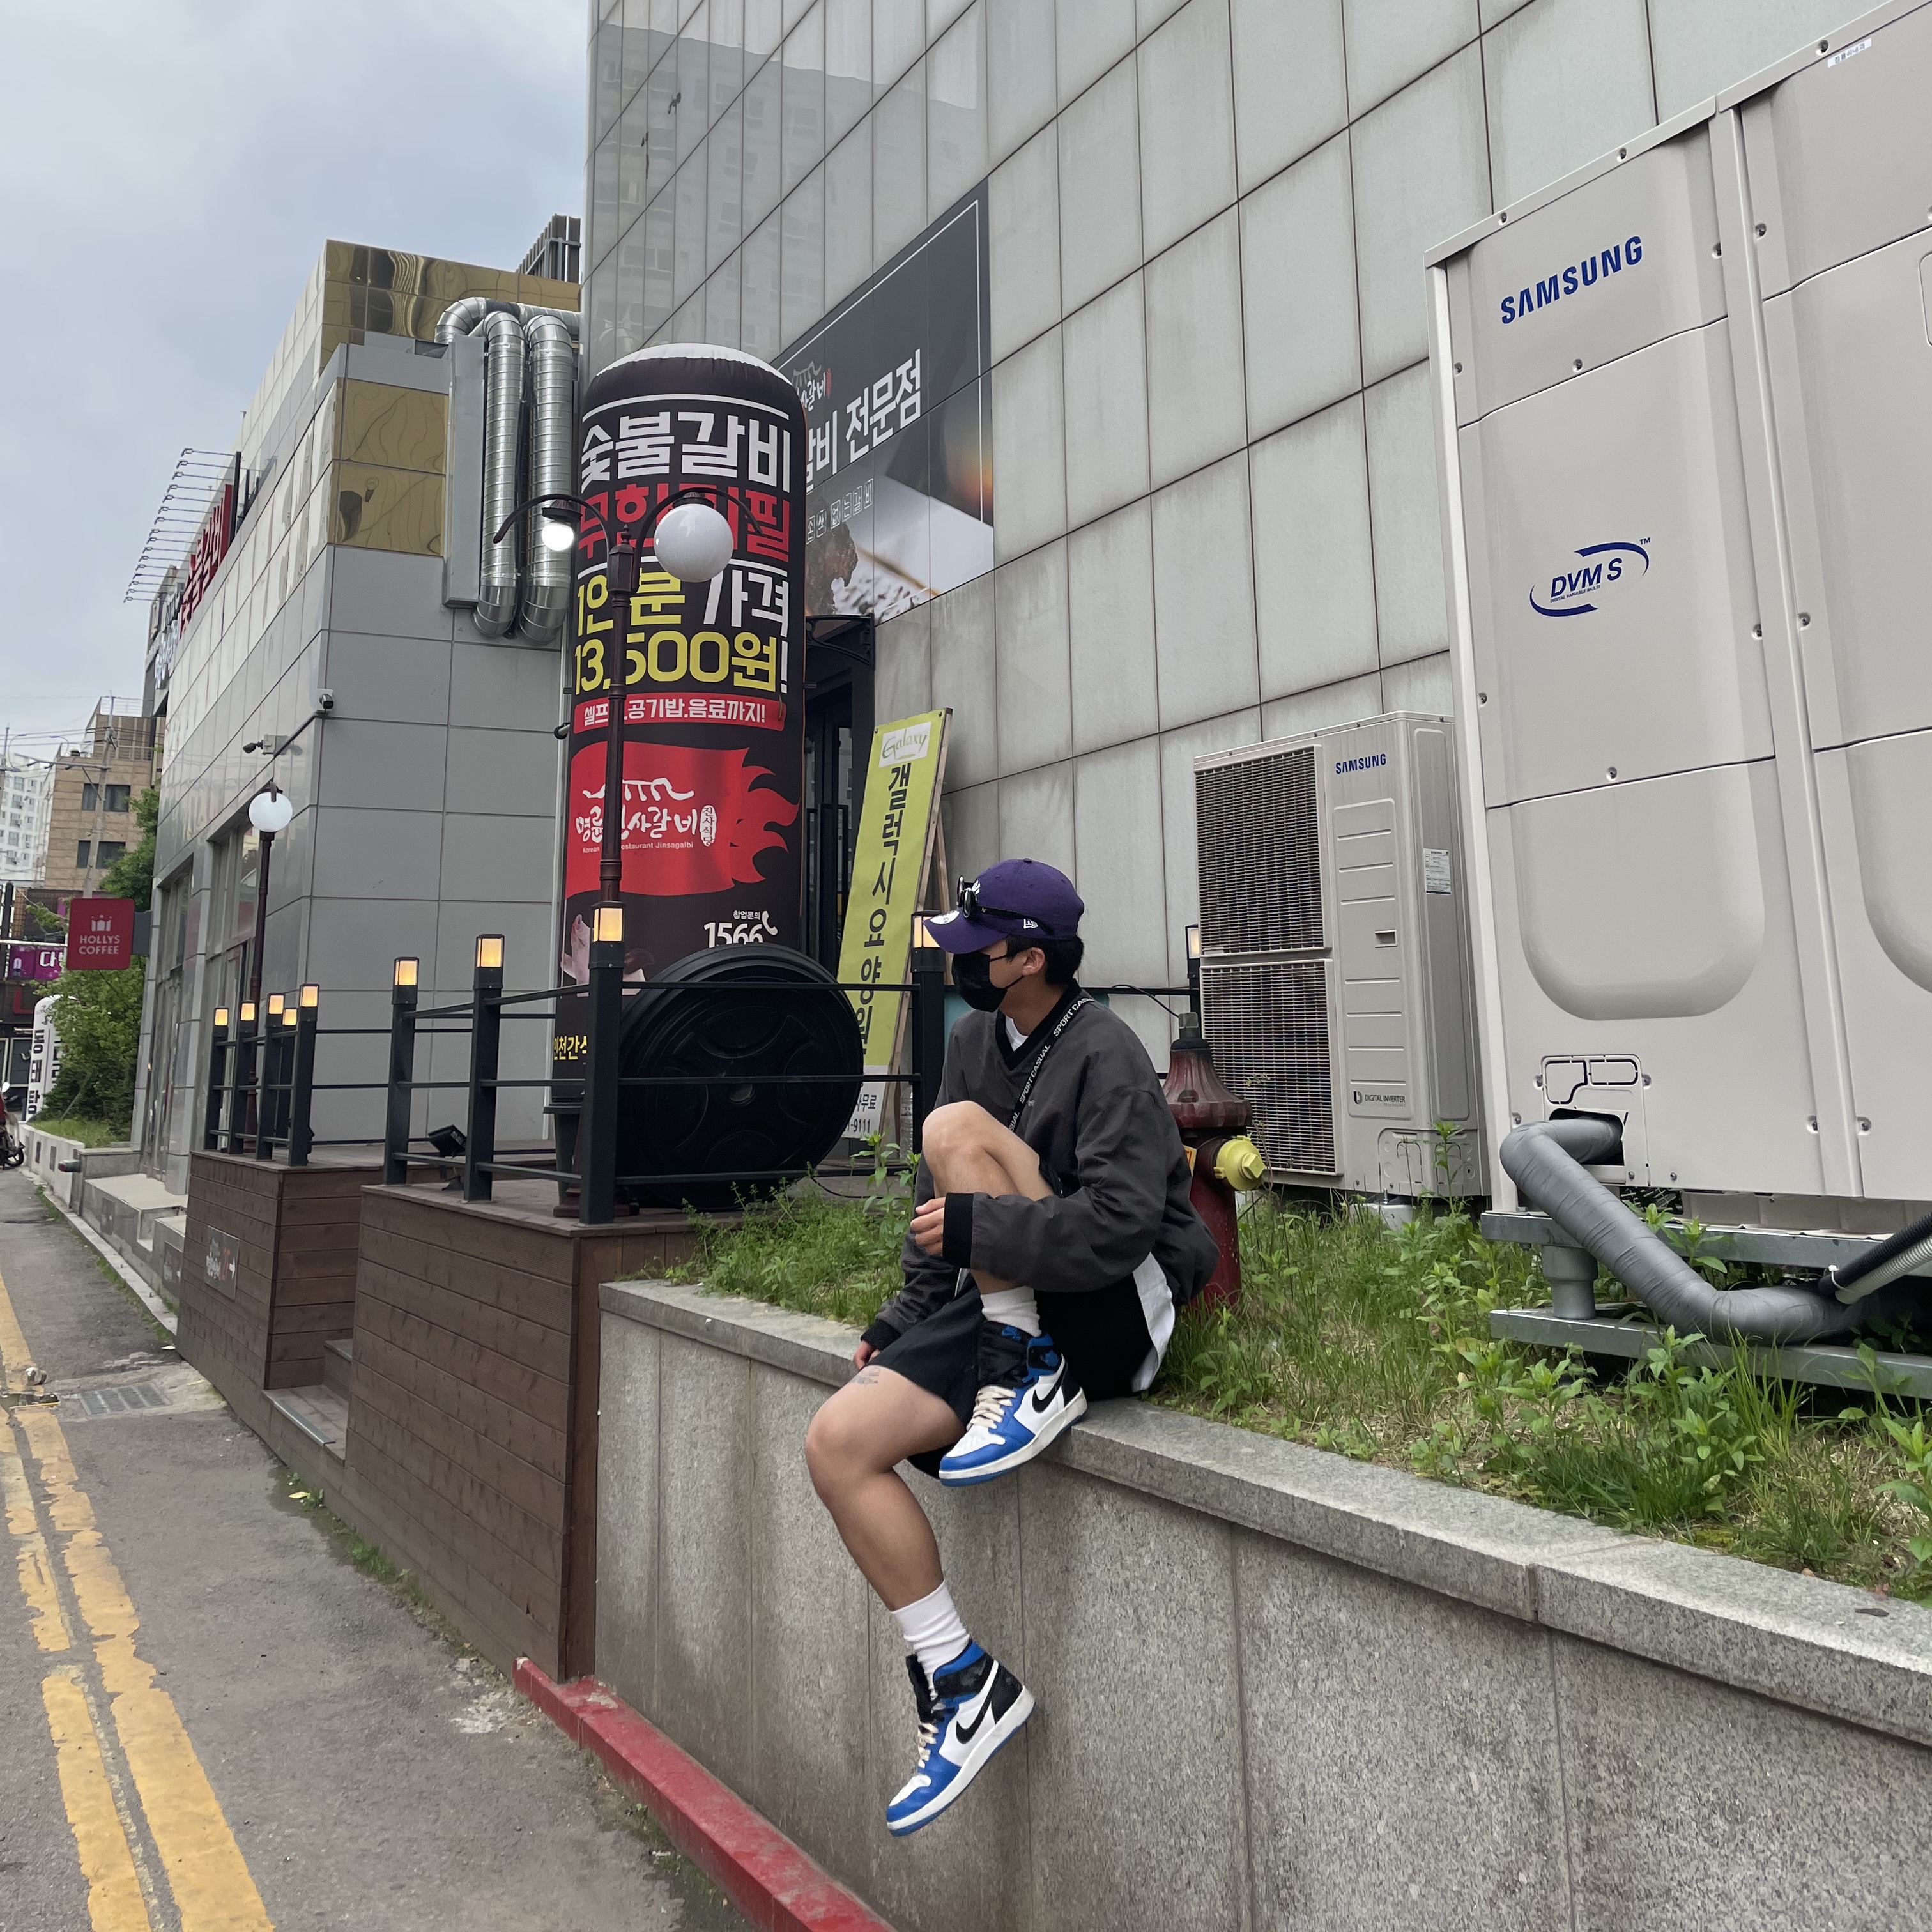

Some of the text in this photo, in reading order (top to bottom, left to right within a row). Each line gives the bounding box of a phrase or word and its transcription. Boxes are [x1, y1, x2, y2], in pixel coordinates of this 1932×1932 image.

[1501, 236, 1643, 324] SAMSUNG
[845, 349, 921, 463] 전문점
[581, 411, 790, 493] 숯불갈비
[1551, 558, 1623, 598] DVM S
[703, 569, 789, 637] 가격
[882, 728, 927, 759] Galaxy
[1335, 753, 1386, 774] SAMSUNG
[621, 842, 654, 850] estaurant
[79, 935, 121, 944] HOLLYS
[704, 922, 763, 949] 1566
[79, 946, 119, 955] COFFEE
[1053, 1009, 1073, 1037] SPORT
[1020, 1044, 1052, 1104] SPORT CASUAL
[1383, 1094, 1406, 1103] INVERTER
